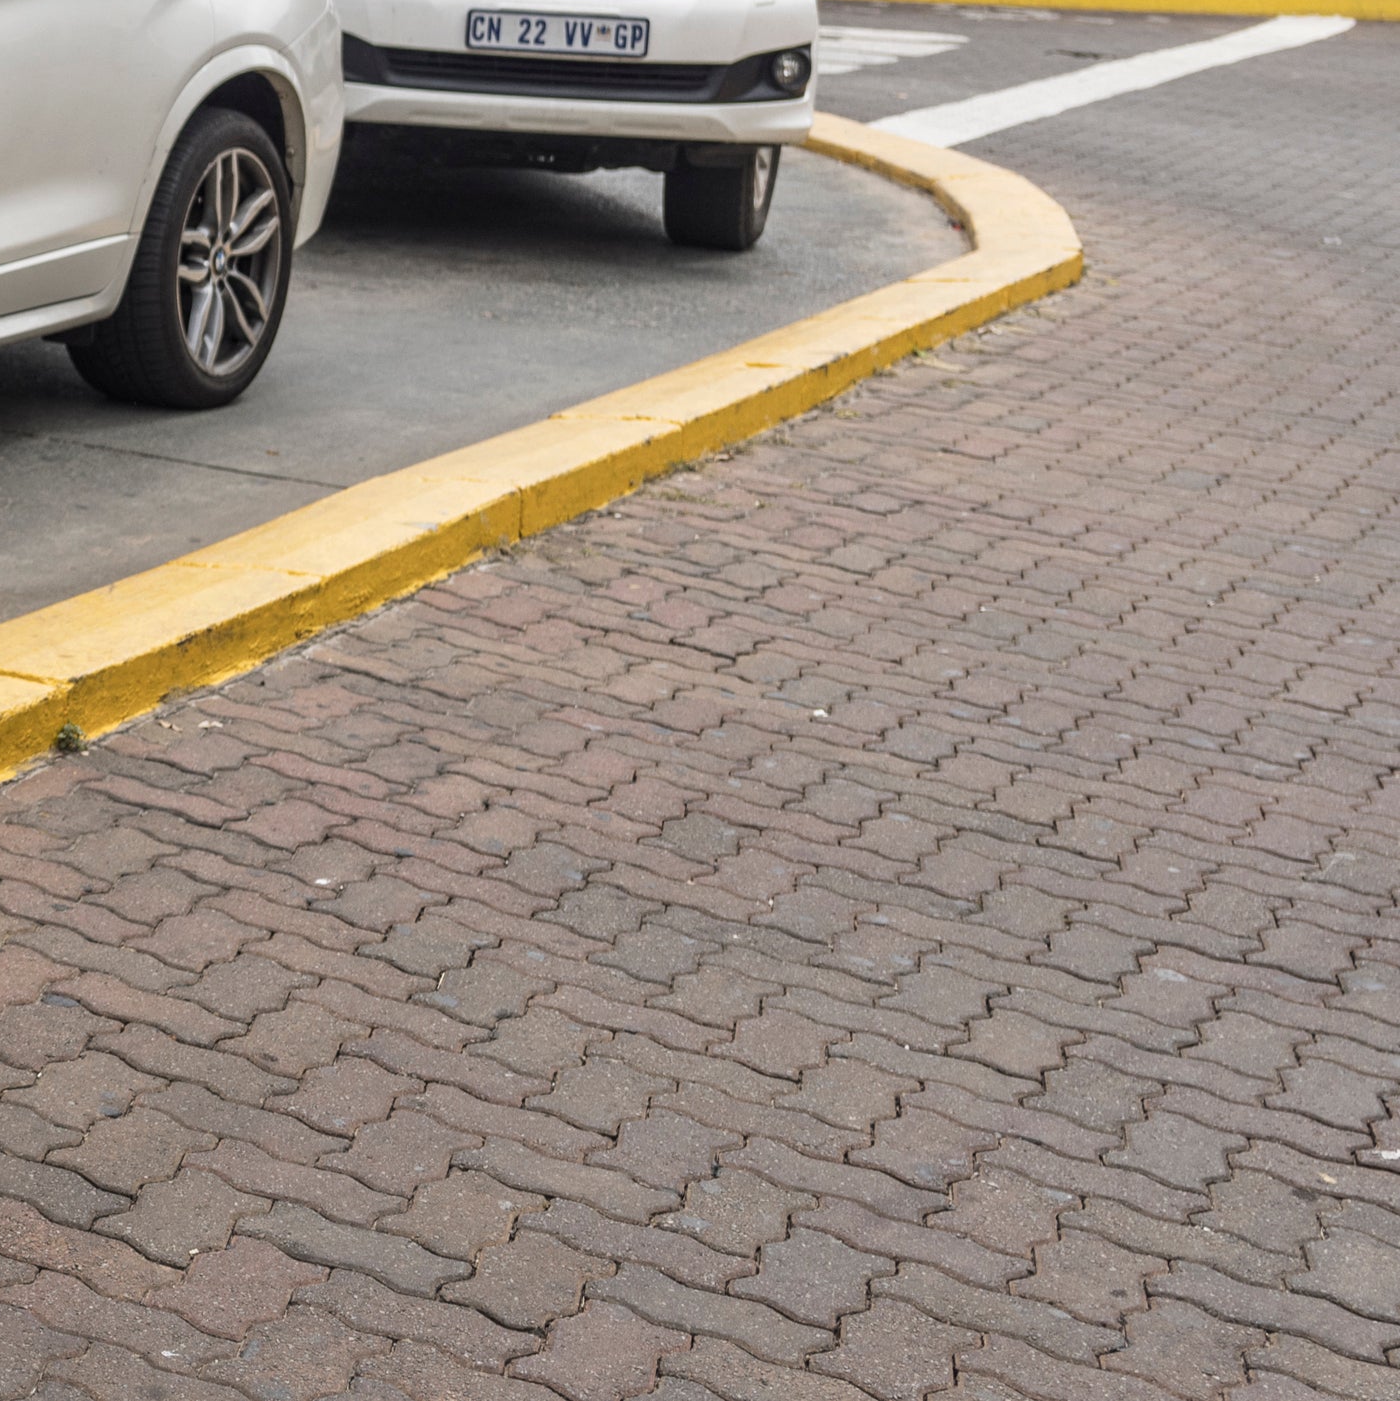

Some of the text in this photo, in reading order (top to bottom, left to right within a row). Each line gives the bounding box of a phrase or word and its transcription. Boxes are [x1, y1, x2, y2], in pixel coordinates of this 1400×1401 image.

[472, 16, 643, 50] CN 22 VV GP
